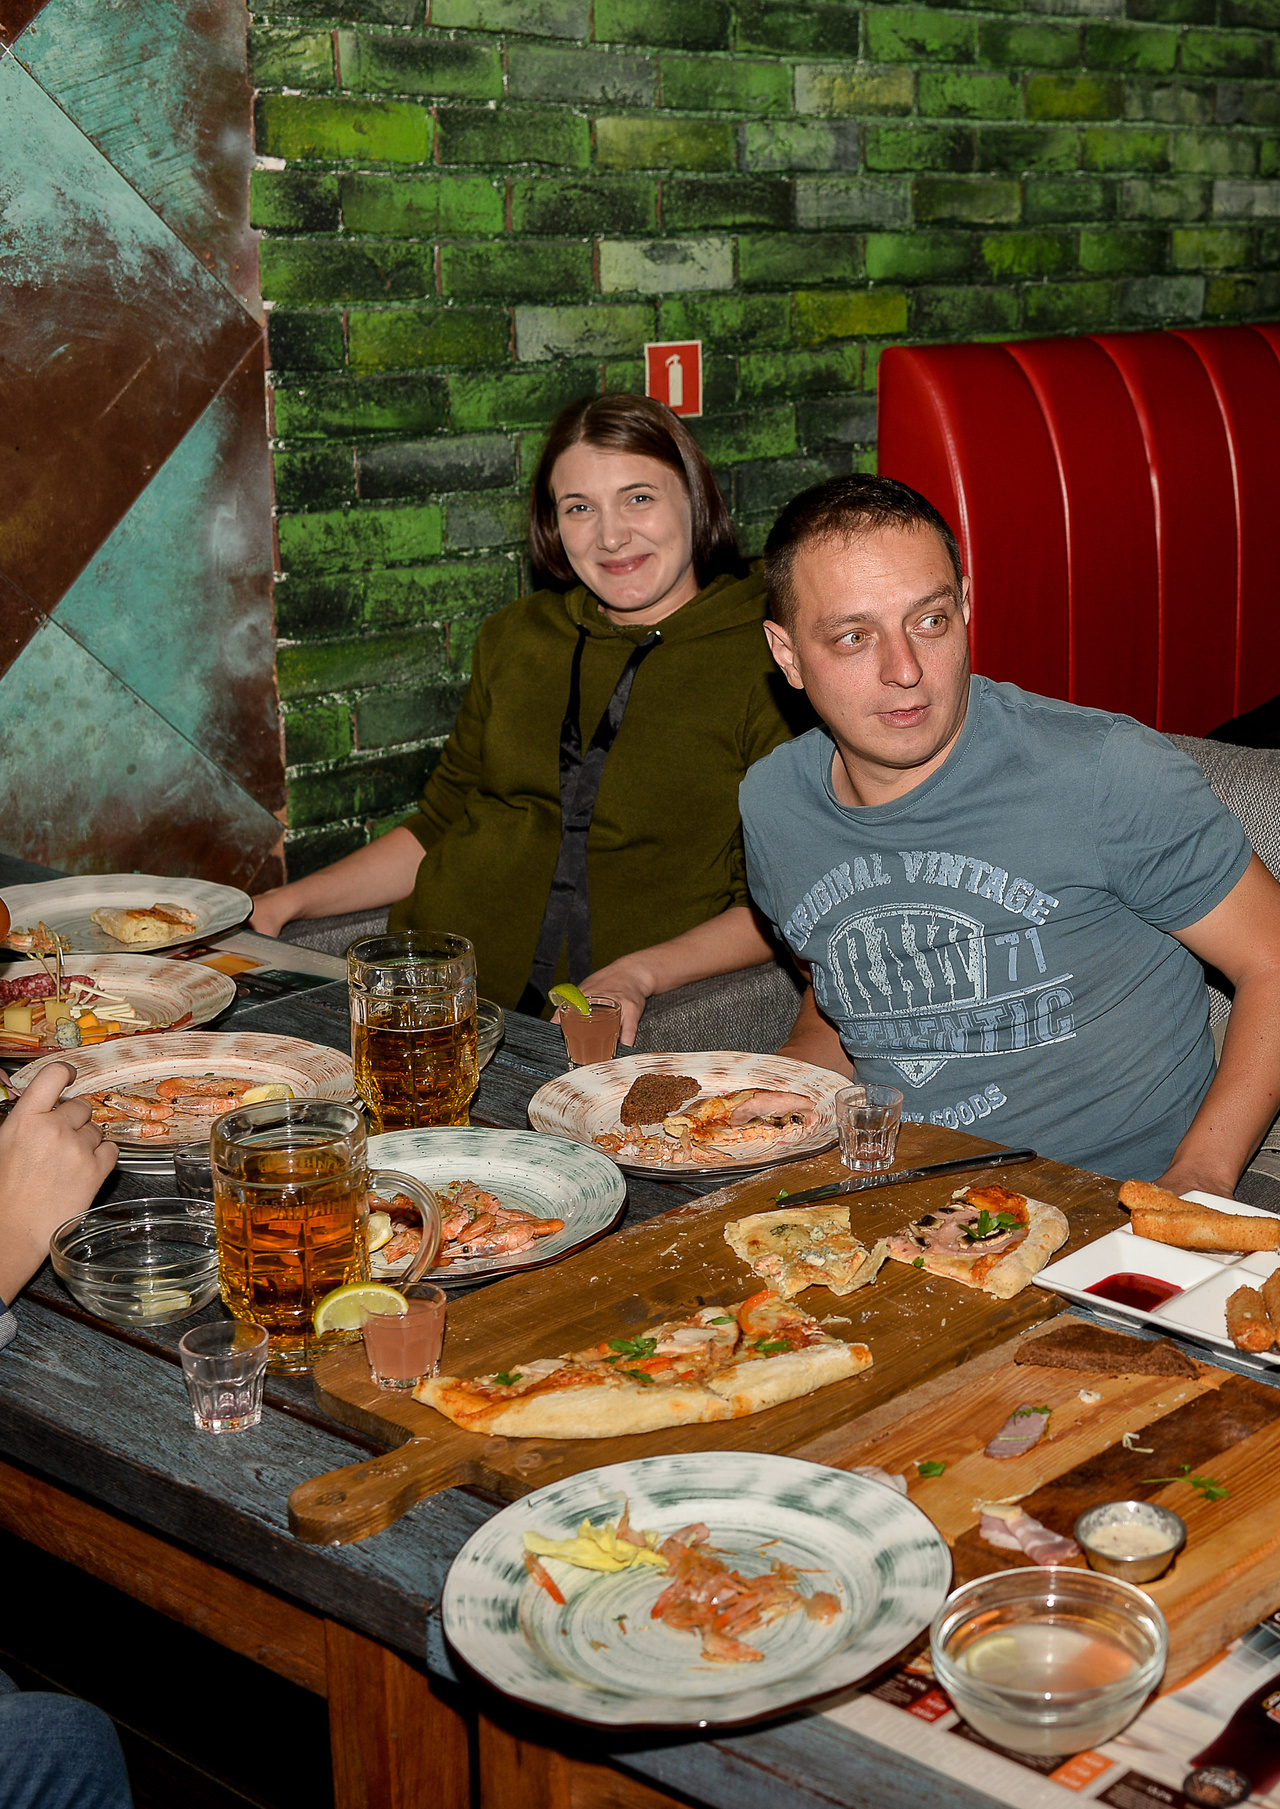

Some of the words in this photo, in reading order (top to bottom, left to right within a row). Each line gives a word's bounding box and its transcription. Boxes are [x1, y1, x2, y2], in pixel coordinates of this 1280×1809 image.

[783, 854, 891, 951] ORIGINAL
[898, 851, 1060, 926] VINTAGE
[930, 1083, 1008, 1130] GOODS
